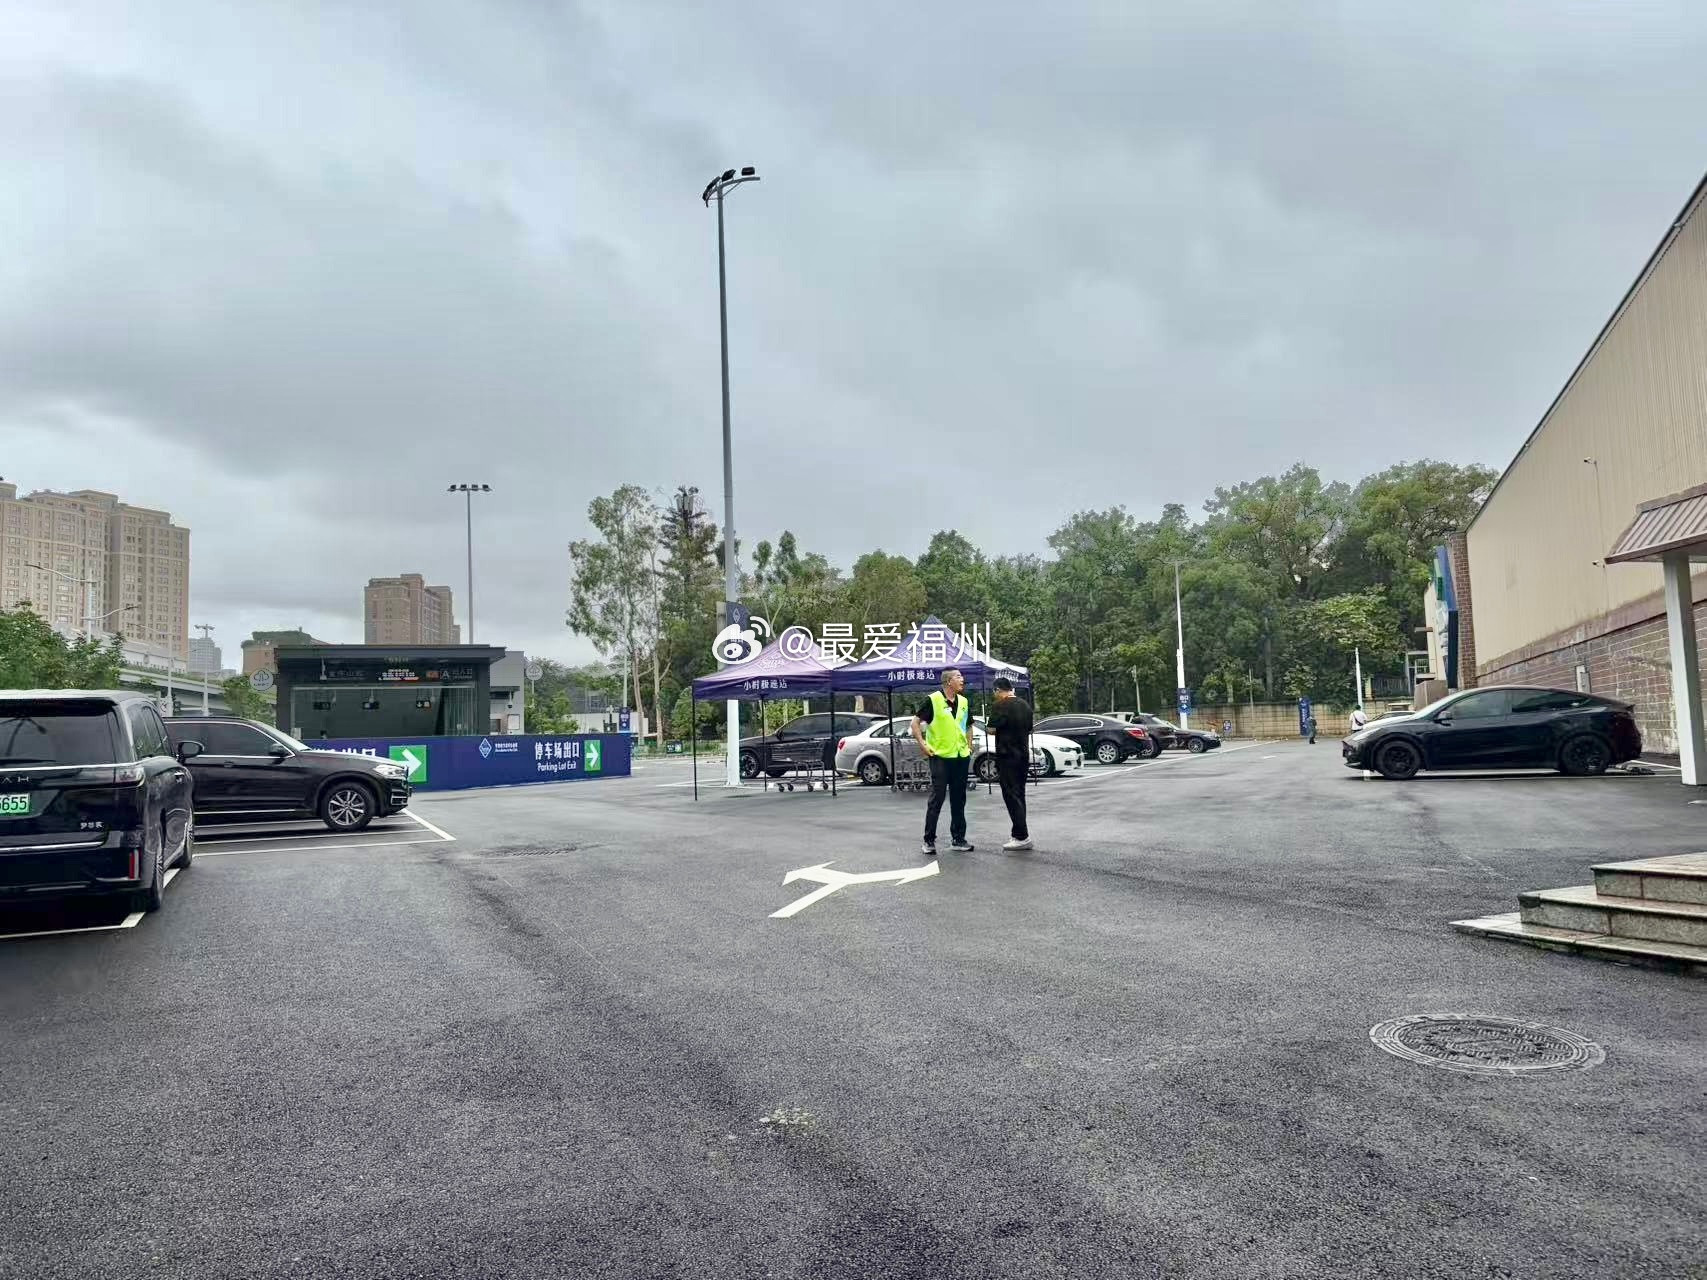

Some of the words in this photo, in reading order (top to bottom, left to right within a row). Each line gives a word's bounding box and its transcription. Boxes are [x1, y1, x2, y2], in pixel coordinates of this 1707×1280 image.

[880, 669, 935, 681] 一小时极速达
[735, 679, 787, 691] 一小时极速达
[535, 741, 580, 760] 停车场出口
[537, 762, 557, 773] Parking
[558, 761, 567, 770] Lot
[567, 760, 577, 770] Exit
[0, 796, 27, 811] 655
